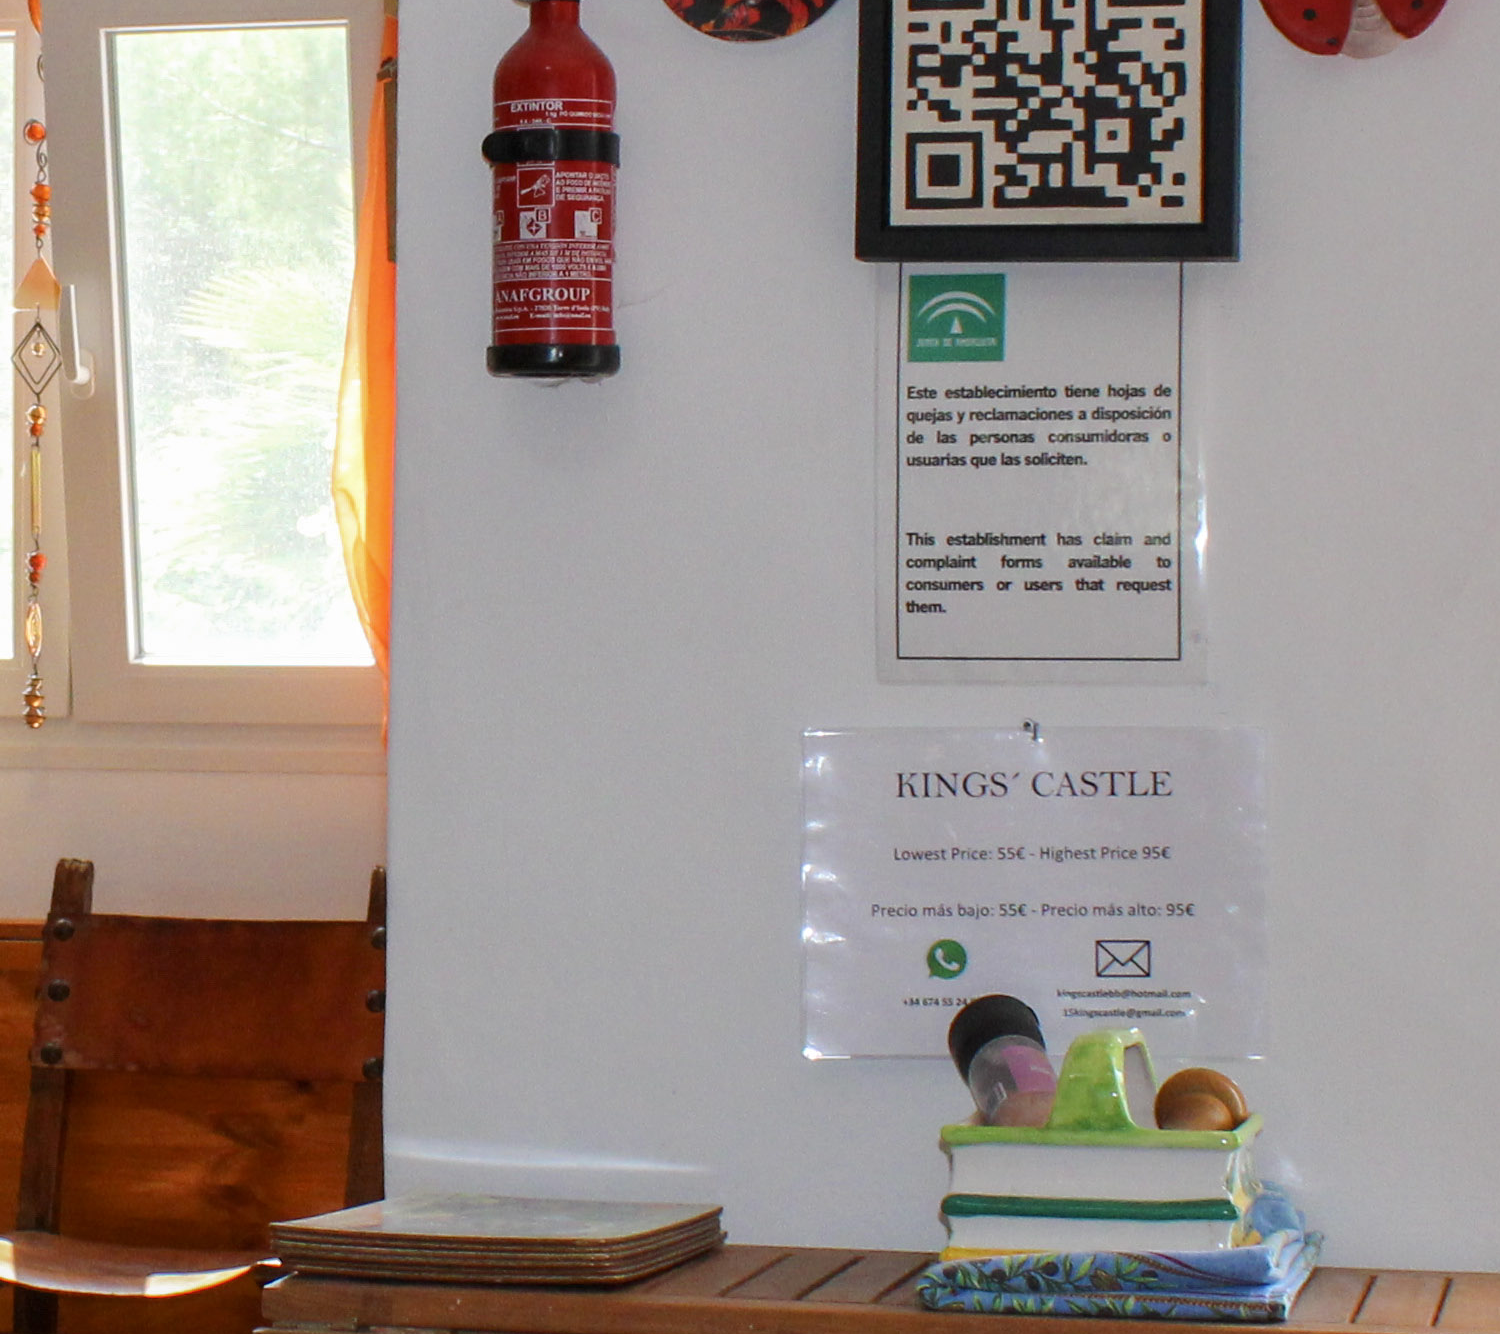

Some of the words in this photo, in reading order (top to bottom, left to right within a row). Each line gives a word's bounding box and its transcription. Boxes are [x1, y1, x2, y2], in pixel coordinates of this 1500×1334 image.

[510, 101, 564, 113] EXTINTOR
[591, 209, 601, 221] C
[495, 287, 591, 304] ANAFGROUP
[906, 386, 938, 399] Este
[944, 385, 1058, 399] establecimiento
[1064, 385, 1101, 398] tiene
[1107, 384, 1146, 401] hojas
[1153, 384, 1173, 398] de
[906, 409, 954, 424] quejas
[957, 411, 965, 424] y
[969, 408, 1074, 421] reclamaciones
[1077, 410, 1088, 421] a
[1090, 406, 1173, 423] disposición
[906, 431, 925, 445] de
[936, 431, 958, 444] las
[970, 433, 1036, 447] personas
[1048, 430, 1150, 443] consumidoras
[1162, 432, 1173, 443] o
[906, 453, 967, 468] usuarias
[970, 456, 998, 469] que
[1000, 453, 1022, 467] las
[1024, 453, 1088, 467] soliciten.
[905, 532, 936, 547] This
[946, 532, 1047, 547] establishment
[1056, 532, 1083, 546] has
[1092, 531, 1133, 546] claim
[1143, 532, 1172, 546] and
[905, 555, 977, 571] complaint
[1000, 555, 1044, 569] forms
[1067, 555, 1132, 569] available
[1156, 555, 1172, 569] to
[905, 579, 985, 592] consumers
[996, 579, 1012, 592] or
[1023, 579, 1064, 592] users
[1074, 578, 1106, 592] that
[1115, 578, 1173, 595] request
[905, 599, 947, 614] them.
[1031, 770, 1174, 798] CASTLE
[893, 847, 947, 861] Lowest
[950, 846, 993, 861] Price:
[997, 846, 1027, 860] 55€
[1039, 846, 1097, 864] Highest
[1100, 845, 1138, 860] Price
[1141, 845, 1172, 860] 95€
[871, 903, 919, 918] Precio
[921, 903, 953, 917] más
[957, 903, 995, 920] bajo:
[998, 902, 1028, 917] 55€
[1040, 903, 1088, 917] Precio
[1091, 902, 1124, 917] más
[1127, 902, 1162, 917] alto:
[1165, 902, 1196, 917] 95€
[922, 997, 940, 1007] 674
[1056, 988, 1192, 1000] kingscastlebb@hotmail.com
